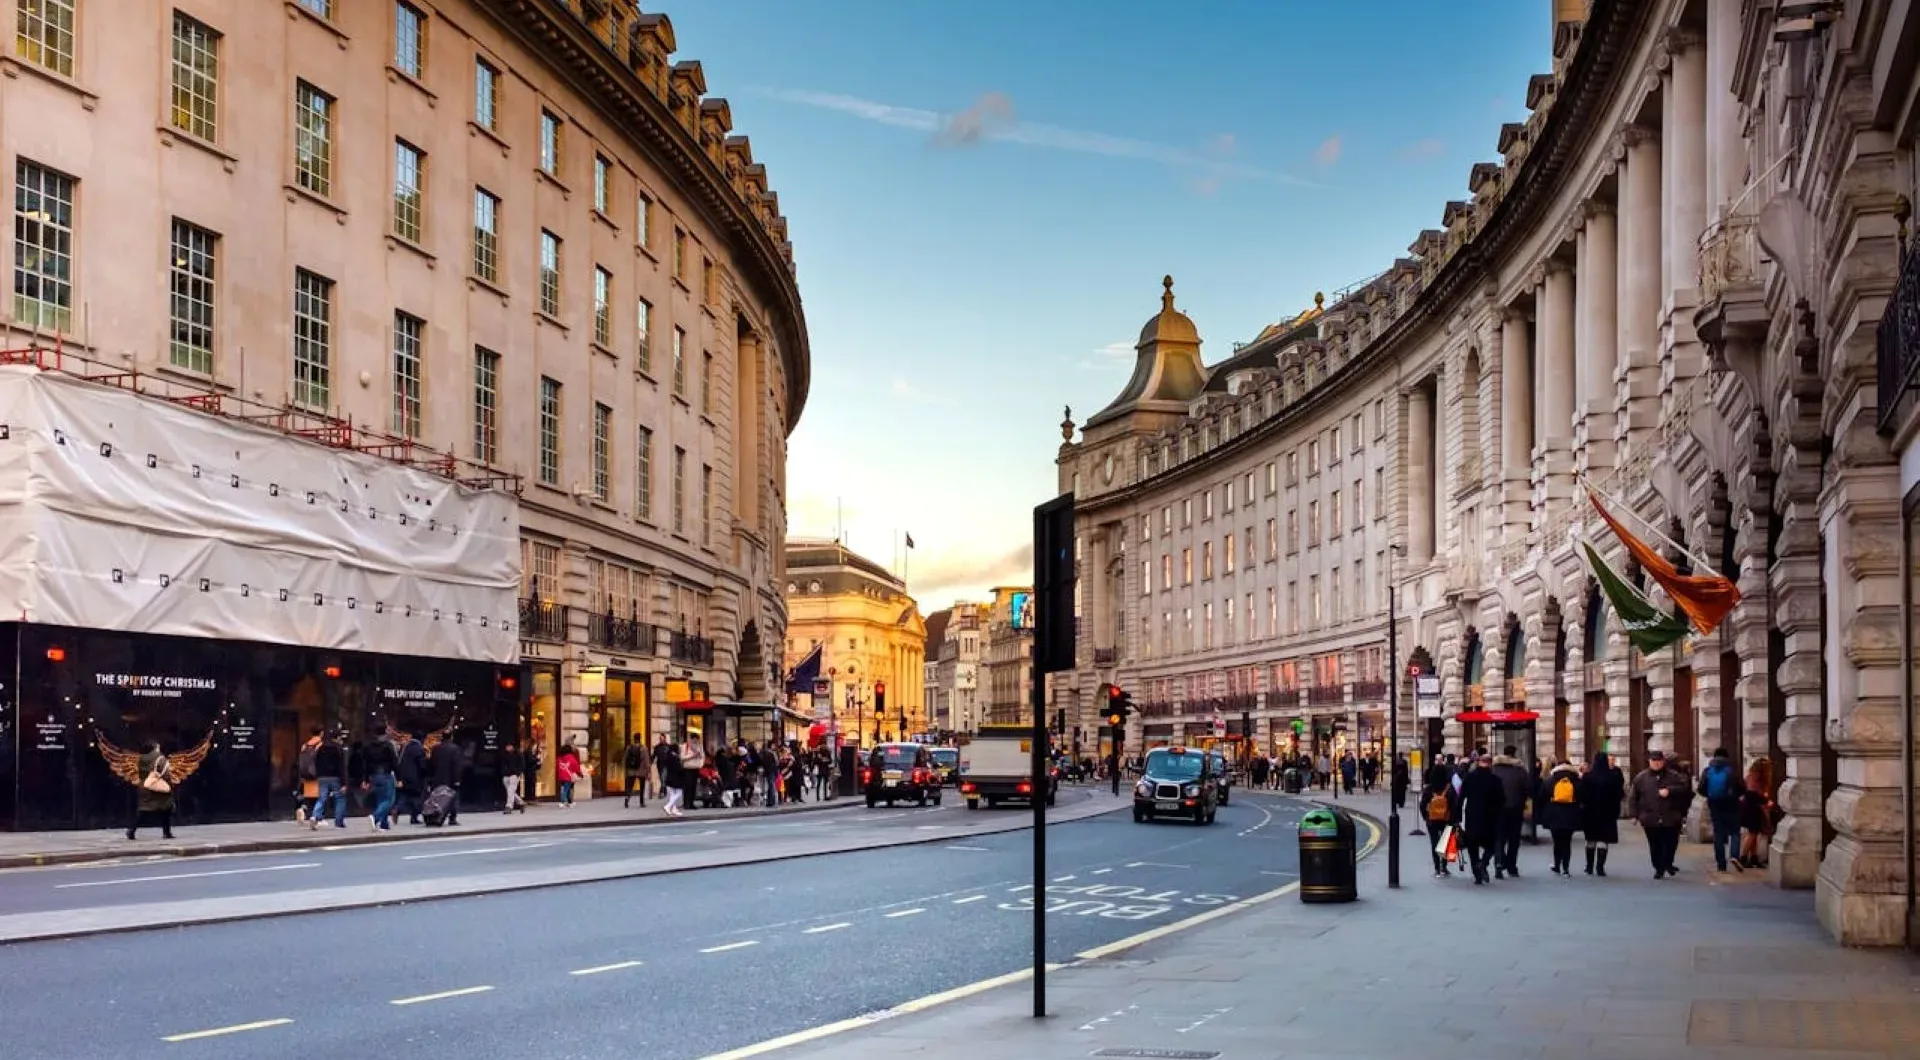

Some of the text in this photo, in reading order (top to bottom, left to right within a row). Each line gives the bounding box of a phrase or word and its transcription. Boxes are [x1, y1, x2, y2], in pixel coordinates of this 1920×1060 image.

[96, 674, 115, 685] THE
[150, 676, 162, 687] OF
[164, 676, 217, 689] CHRISTMAS
[384, 689, 395, 698] THE
[997, 898, 1172, 920] BUS
